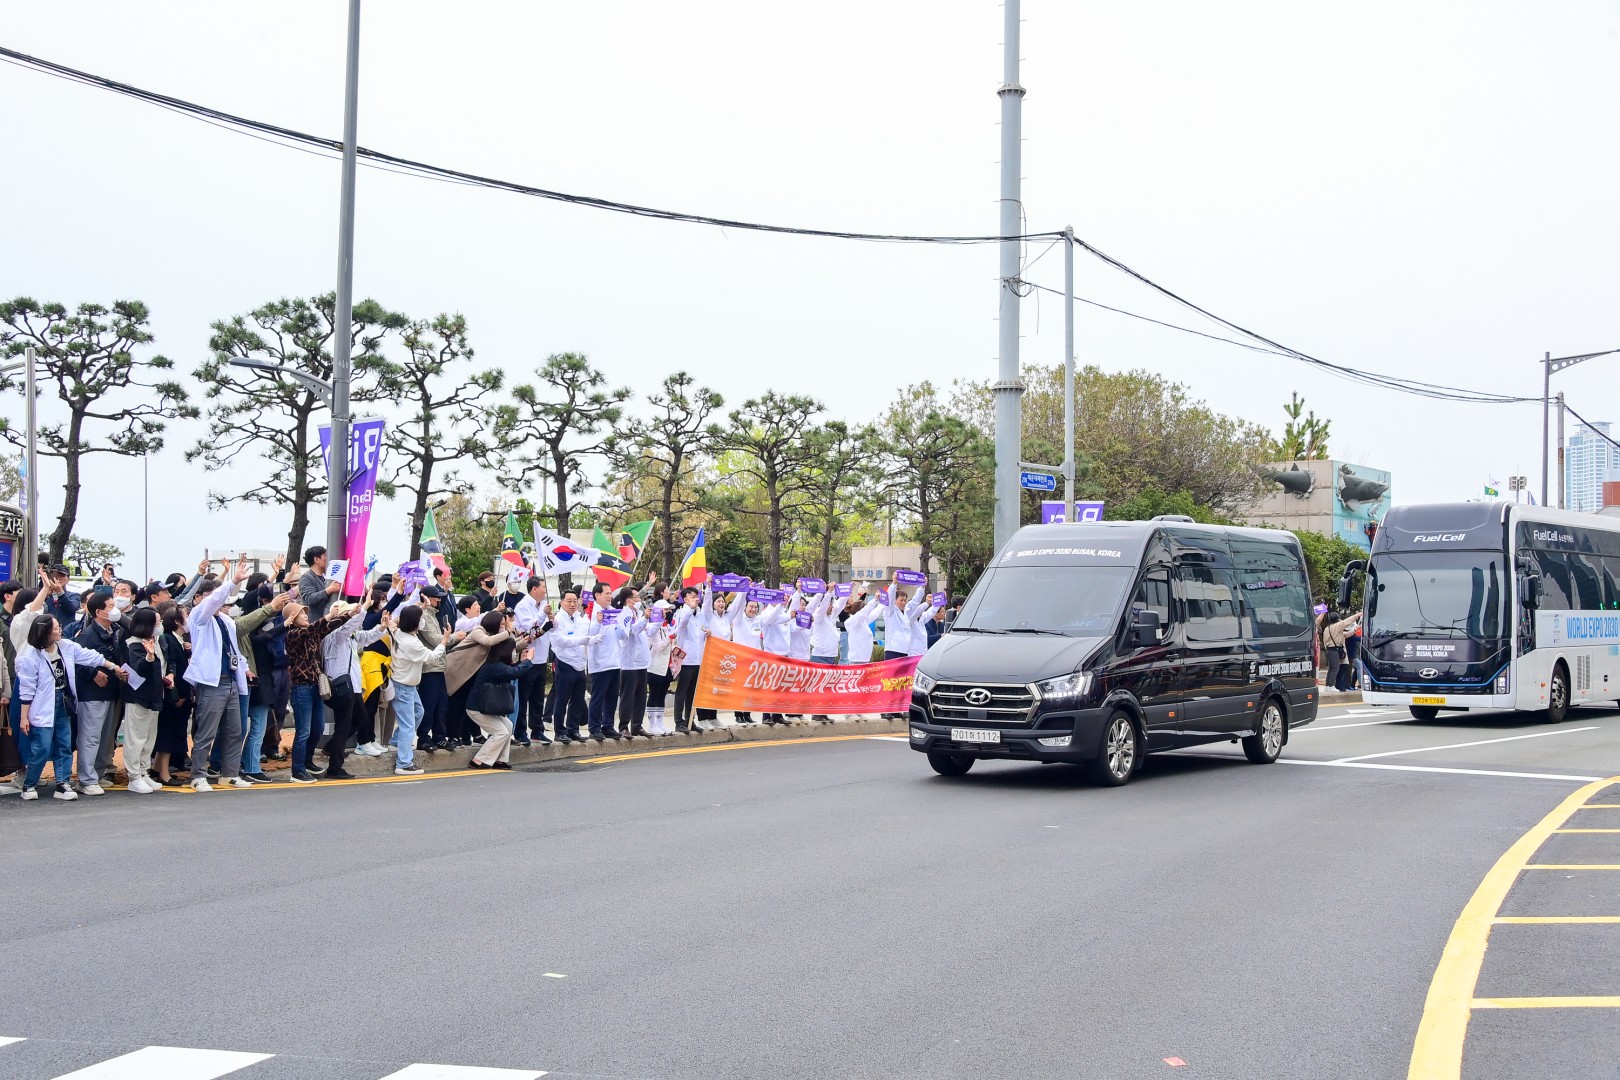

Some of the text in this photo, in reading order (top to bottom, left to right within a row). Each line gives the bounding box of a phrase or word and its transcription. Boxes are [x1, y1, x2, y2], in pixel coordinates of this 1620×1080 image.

[1567, 617, 1588, 638] WORLD
[1589, 617, 1603, 638] EXPO
[1604, 617, 1619, 638] 2030
[1416, 650, 1433, 658] BUSAN,
[1443, 644, 1456, 652] 2030
[1259, 664, 1271, 676] WORLD
[1272, 664, 1280, 674] EXPO
[743, 660, 864, 694] 2030부산세계박람회
